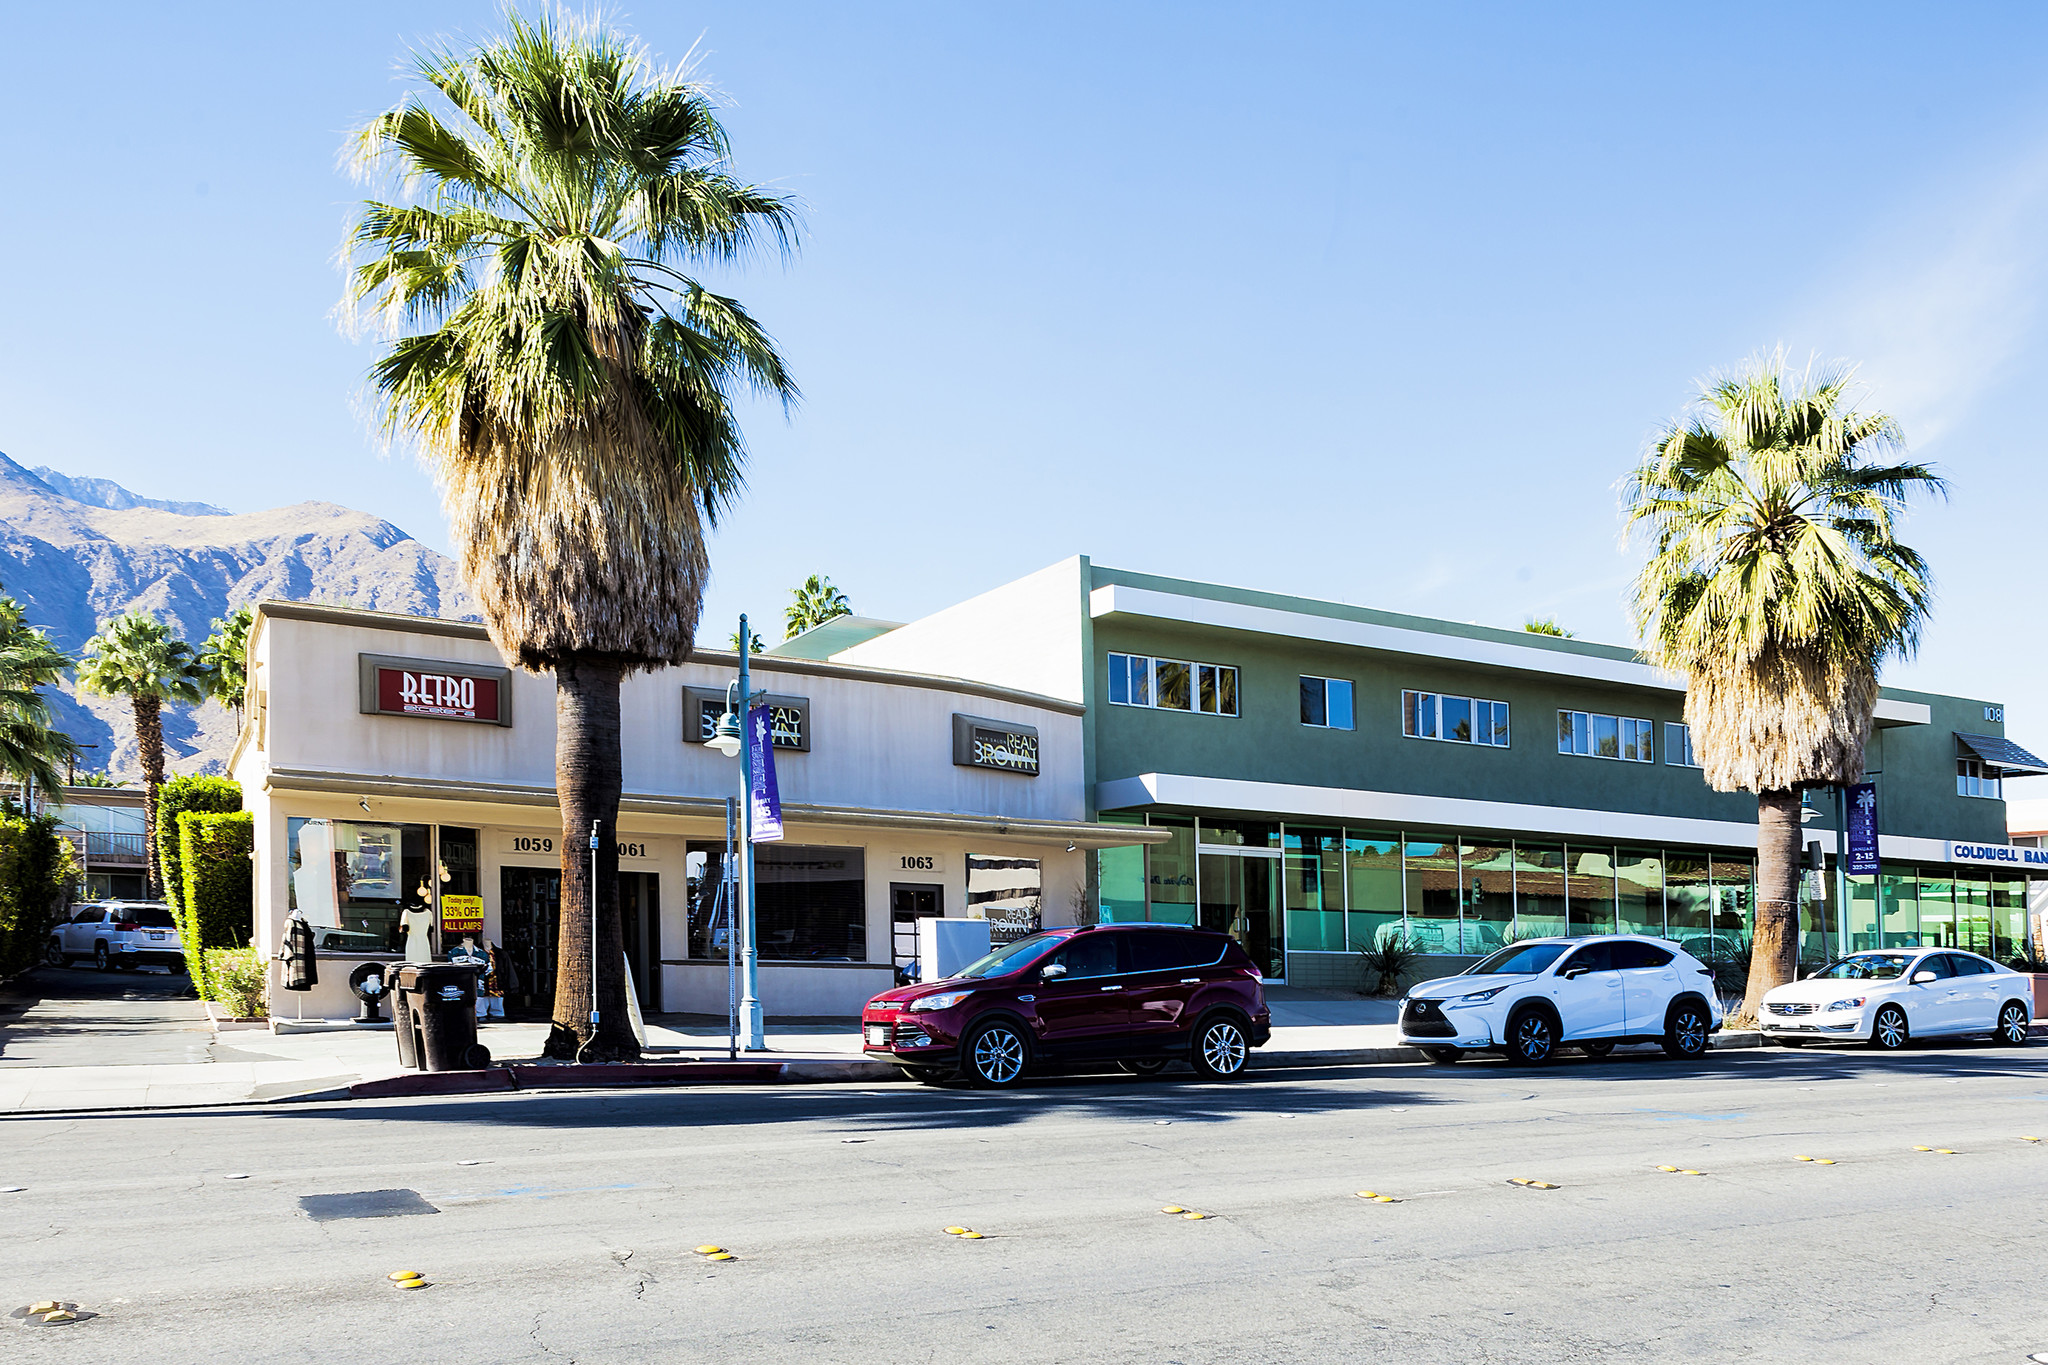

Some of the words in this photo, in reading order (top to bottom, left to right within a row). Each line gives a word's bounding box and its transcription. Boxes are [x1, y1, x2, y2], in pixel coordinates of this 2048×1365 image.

[399, 671, 475, 709] RETRO
[1006, 733, 1038, 751] READ
[974, 740, 1037, 771] BROWN
[513, 837, 553, 852] 1059
[617, 842, 647, 857] 061
[900, 856, 933, 870] 1063
[1855, 852, 1874, 860] 2-15
[447, 896, 462, 904] Today
[445, 906, 462, 917] 33%
[464, 906, 480, 917] OFF
[1006, 907, 1030, 920] READ
[444, 921, 458, 930] ALL
[459, 921, 482, 930] LAMPS
